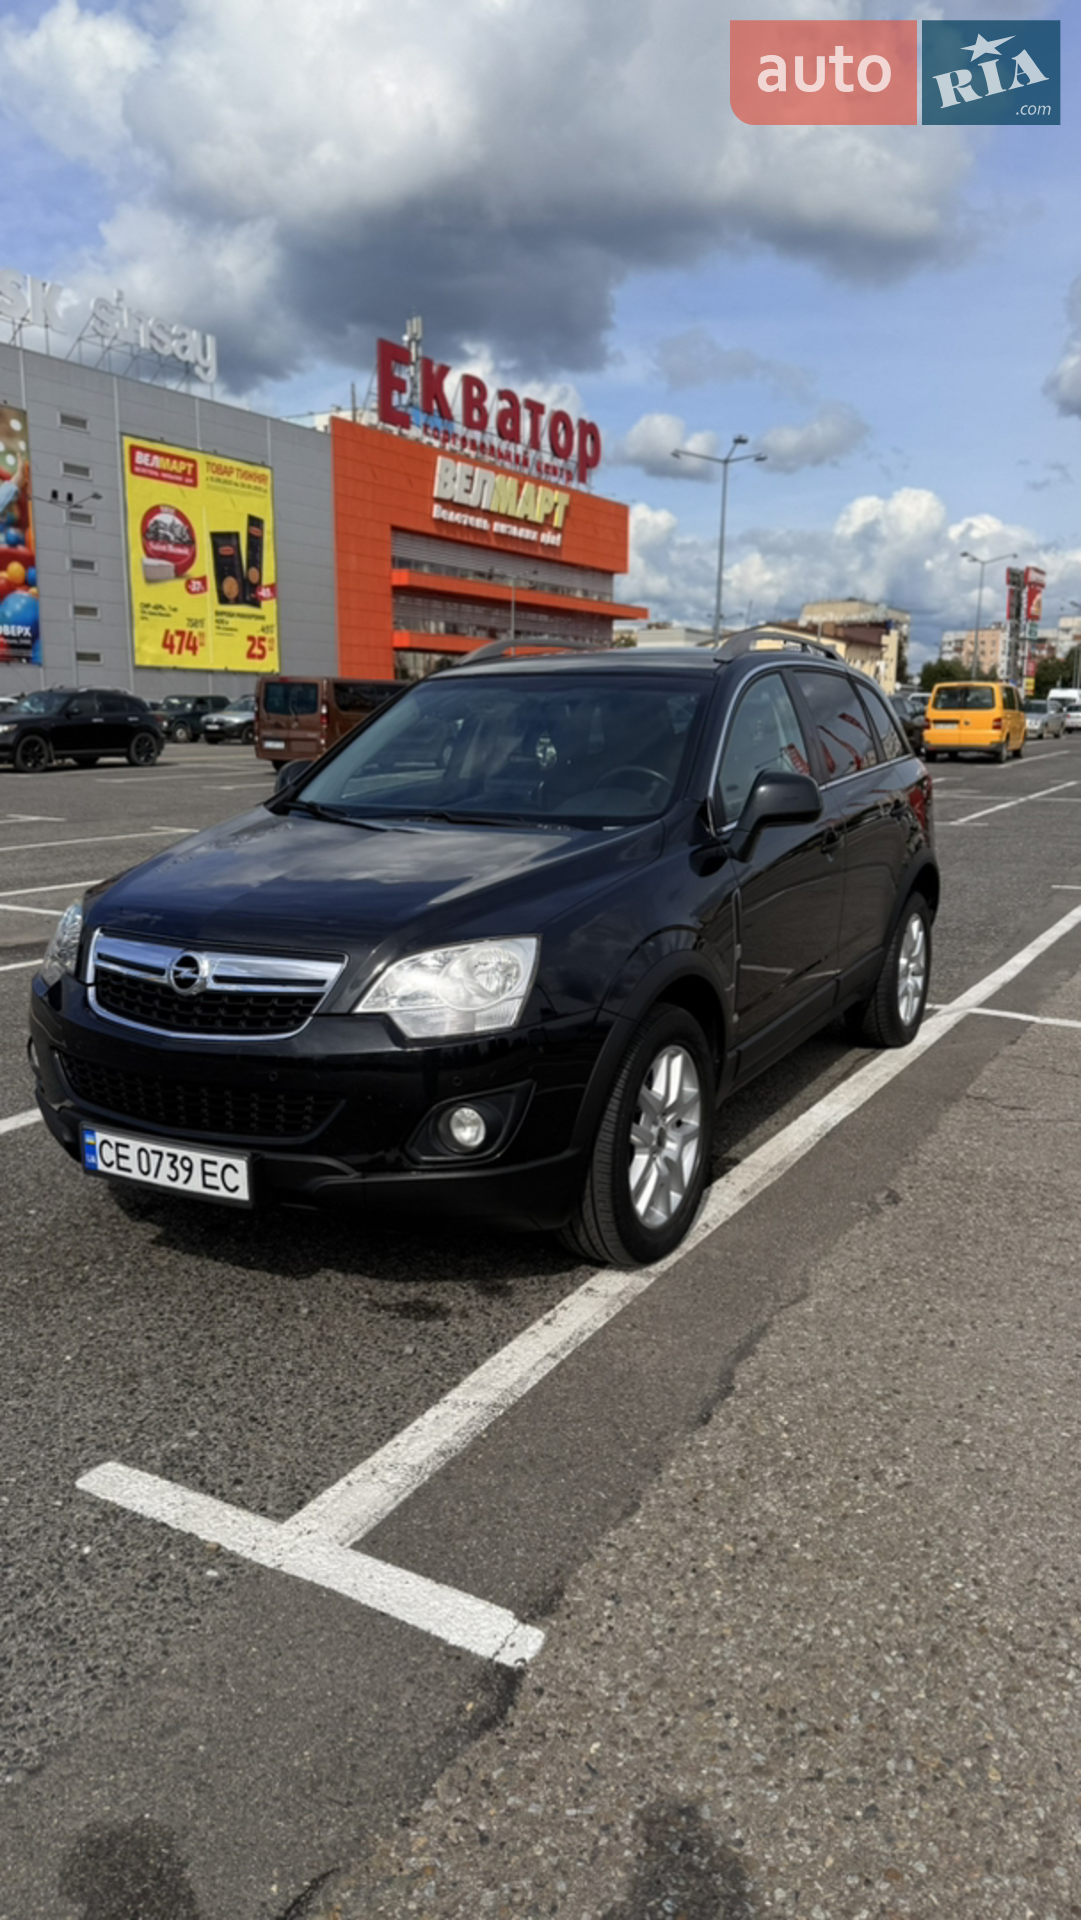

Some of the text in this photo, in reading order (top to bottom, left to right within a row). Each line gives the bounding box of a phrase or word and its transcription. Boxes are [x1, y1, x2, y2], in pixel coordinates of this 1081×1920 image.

[90, 289, 216, 383] sinsay
[433, 455, 570, 529] ВЕЛМАРТ
[161, 629, 199, 656] 474
[246, 635, 267, 660] 25
[99, 1138, 240, 1194] CE 0739 EC
